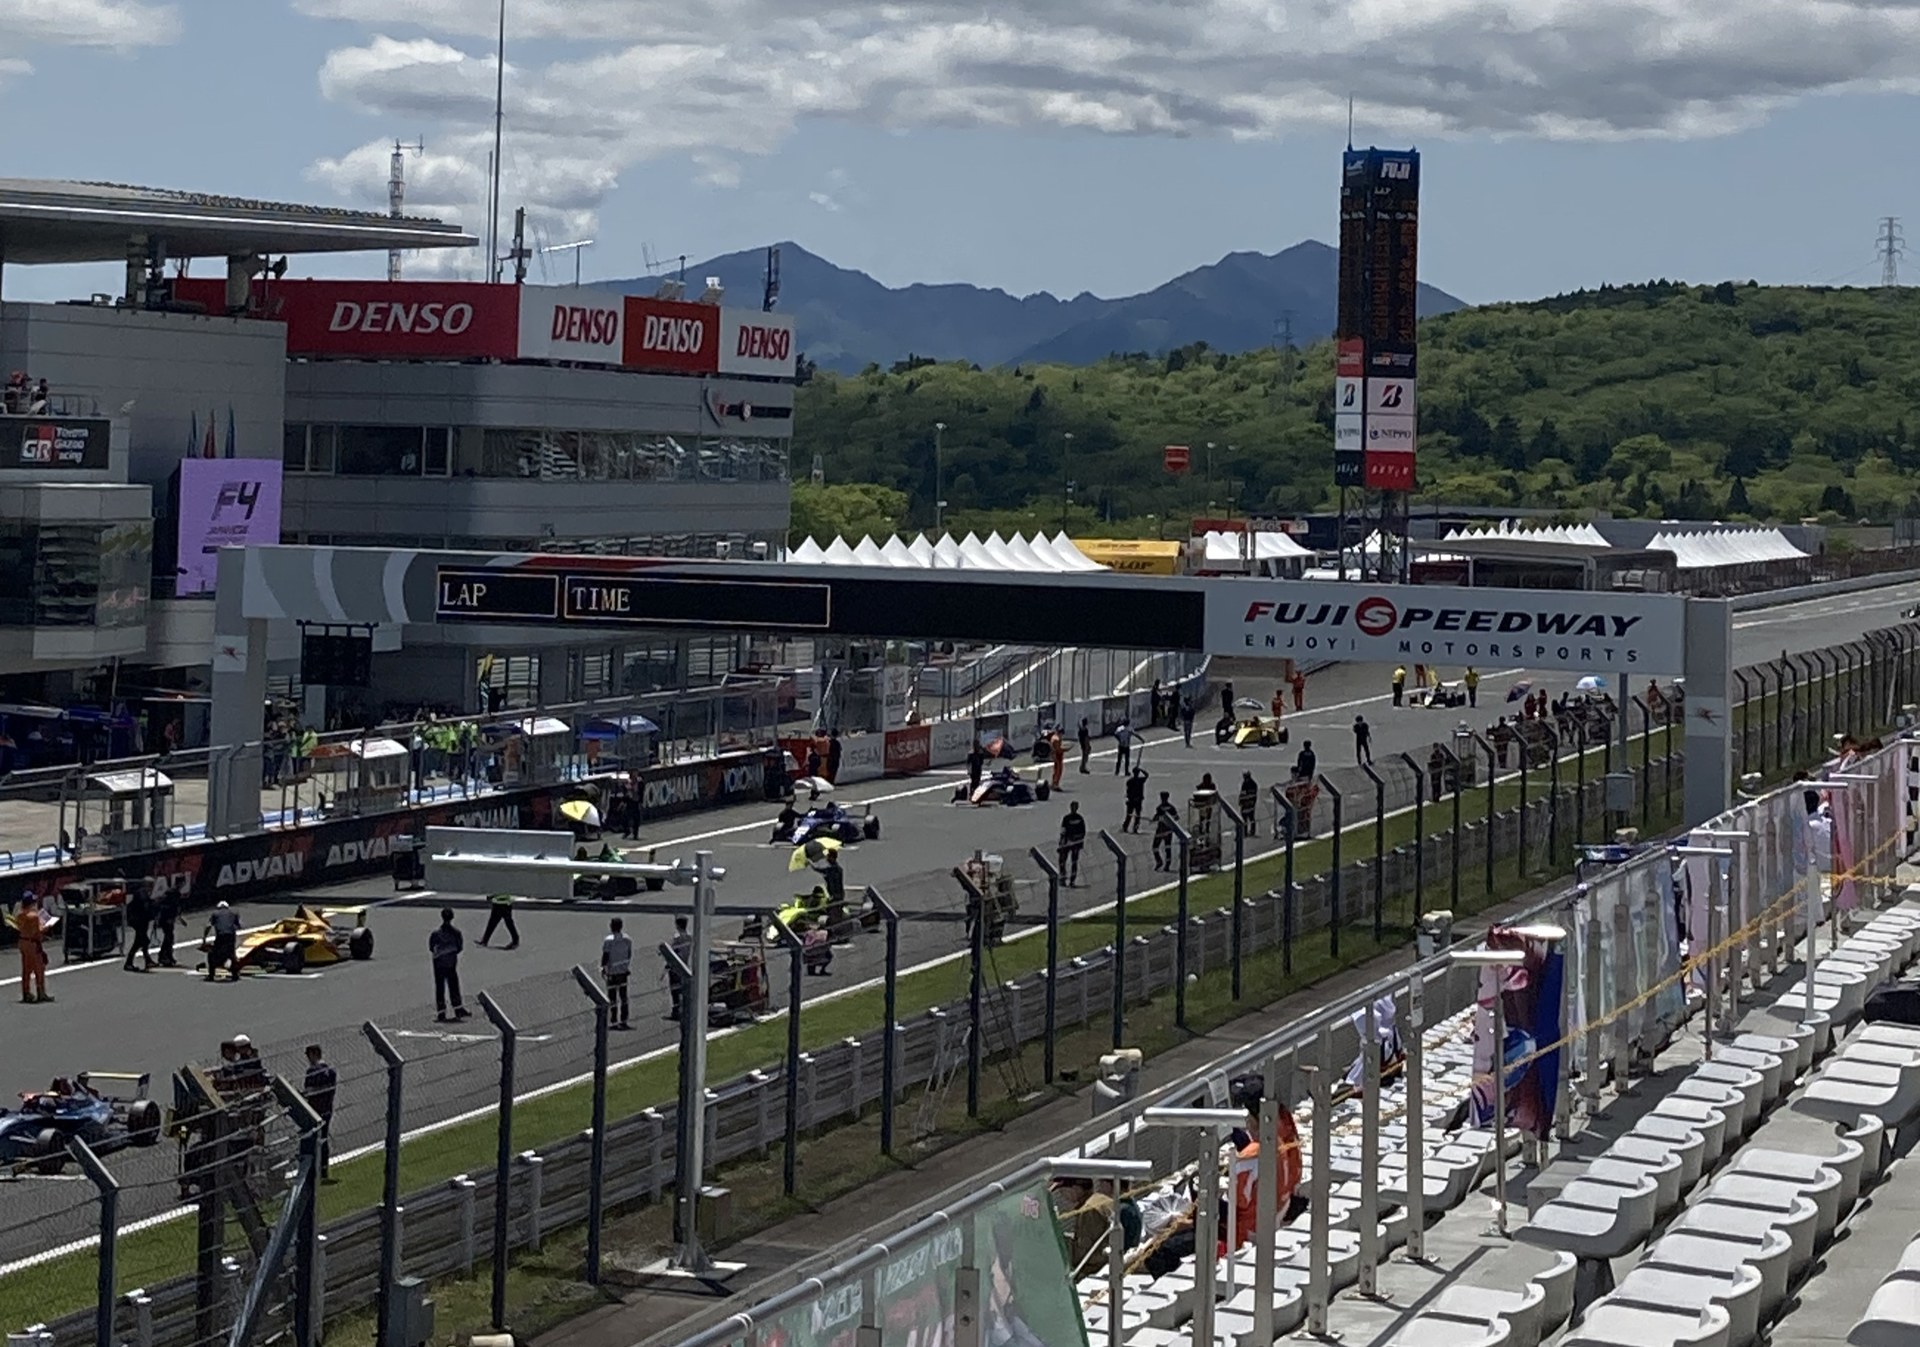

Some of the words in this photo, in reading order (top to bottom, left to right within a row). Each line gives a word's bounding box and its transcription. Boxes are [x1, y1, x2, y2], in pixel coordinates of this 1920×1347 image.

[1380, 161, 1411, 180] FUJI
[329, 301, 473, 336] DENSO
[552, 305, 619, 346] DENSO
[643, 316, 704, 355] DENSO
[737, 325, 791, 361] DENSO
[22, 438, 52, 462] GR
[211, 480, 262, 522] F4
[443, 582, 487, 608] LAP
[571, 587, 631, 613] TIME
[1244, 601, 1350, 626] FUJI
[1355, 596, 1643, 638] SPEEDWAY
[1398, 641, 1640, 663] MOTORSPORTS
[887, 738, 928, 760] NISSAN
[215, 851, 304, 889] ADVAN
